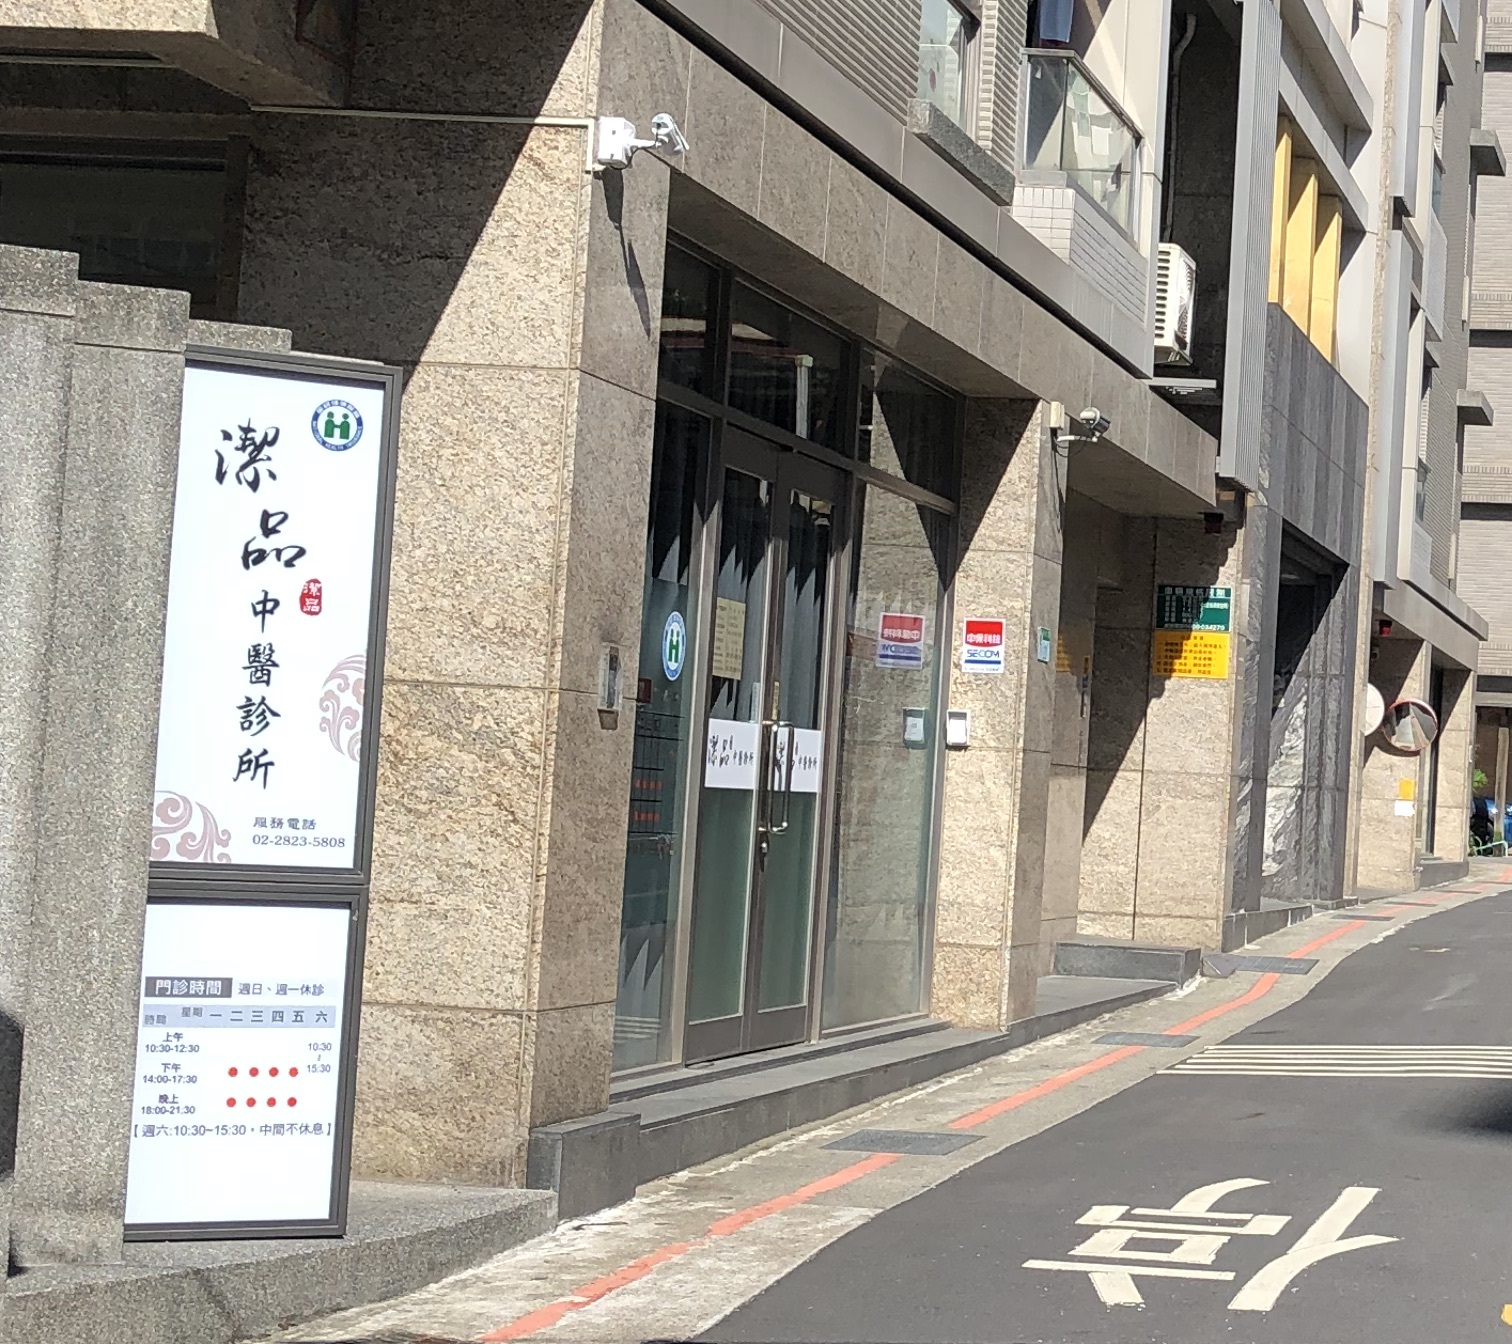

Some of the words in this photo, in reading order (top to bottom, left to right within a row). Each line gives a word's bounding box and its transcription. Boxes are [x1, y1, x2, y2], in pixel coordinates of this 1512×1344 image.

[214, 417, 307, 790] 潔品中醫診所
[967, 649, 1000, 659] SECOM
[253, 817, 317, 831] 服務電話
[252, 833, 346, 849] 02-2823-5808
[155, 980, 223, 997] 門診時間
[238, 983, 325, 997] 週日、週一休診
[163, 1032, 183, 1043] 上午
[145, 1043, 199, 1054] 10:30-12:30
[308, 1042, 332, 1052] 10:30
[161, 1062, 181, 1073] 下午
[307, 1064, 331, 1074] 15:30
[143, 1074, 197, 1084] 14:00-17:30
[141, 1105, 196, 1116] 18:00-21:30
[1021, 1178, 1398, 1311] 停
